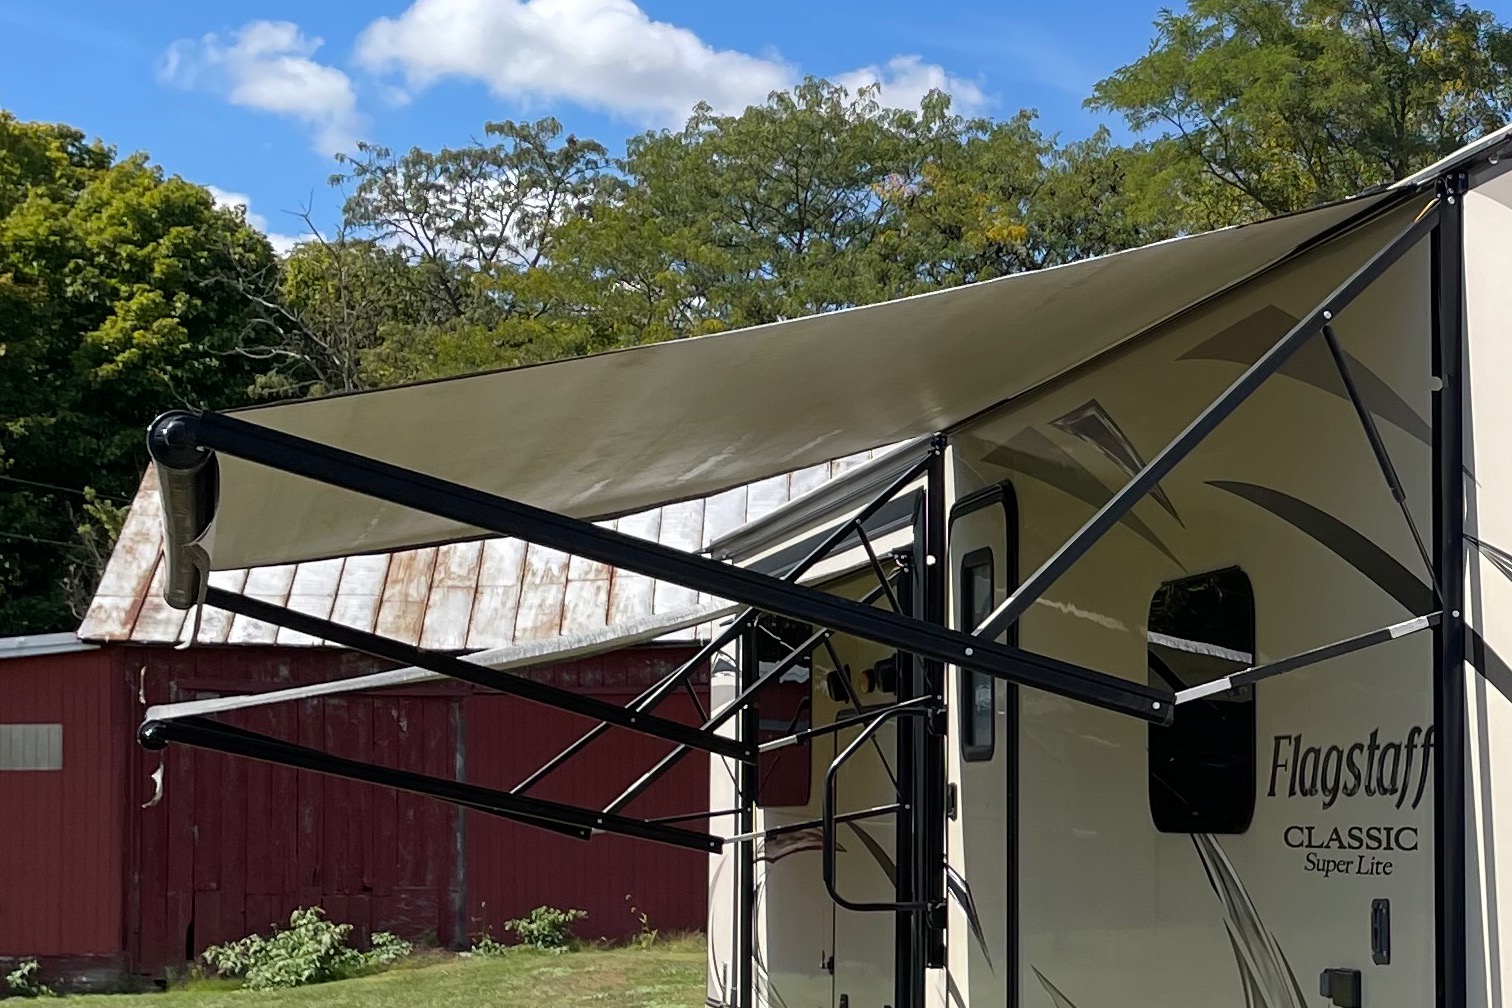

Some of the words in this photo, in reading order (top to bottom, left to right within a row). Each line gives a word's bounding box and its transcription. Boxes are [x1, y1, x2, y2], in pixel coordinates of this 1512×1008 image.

[1267, 725, 1434, 810] Flagstaff
[1284, 825, 1418, 850] CLASSIC
[1304, 852, 1354, 877] Super
[1356, 855, 1393, 875] Lite
